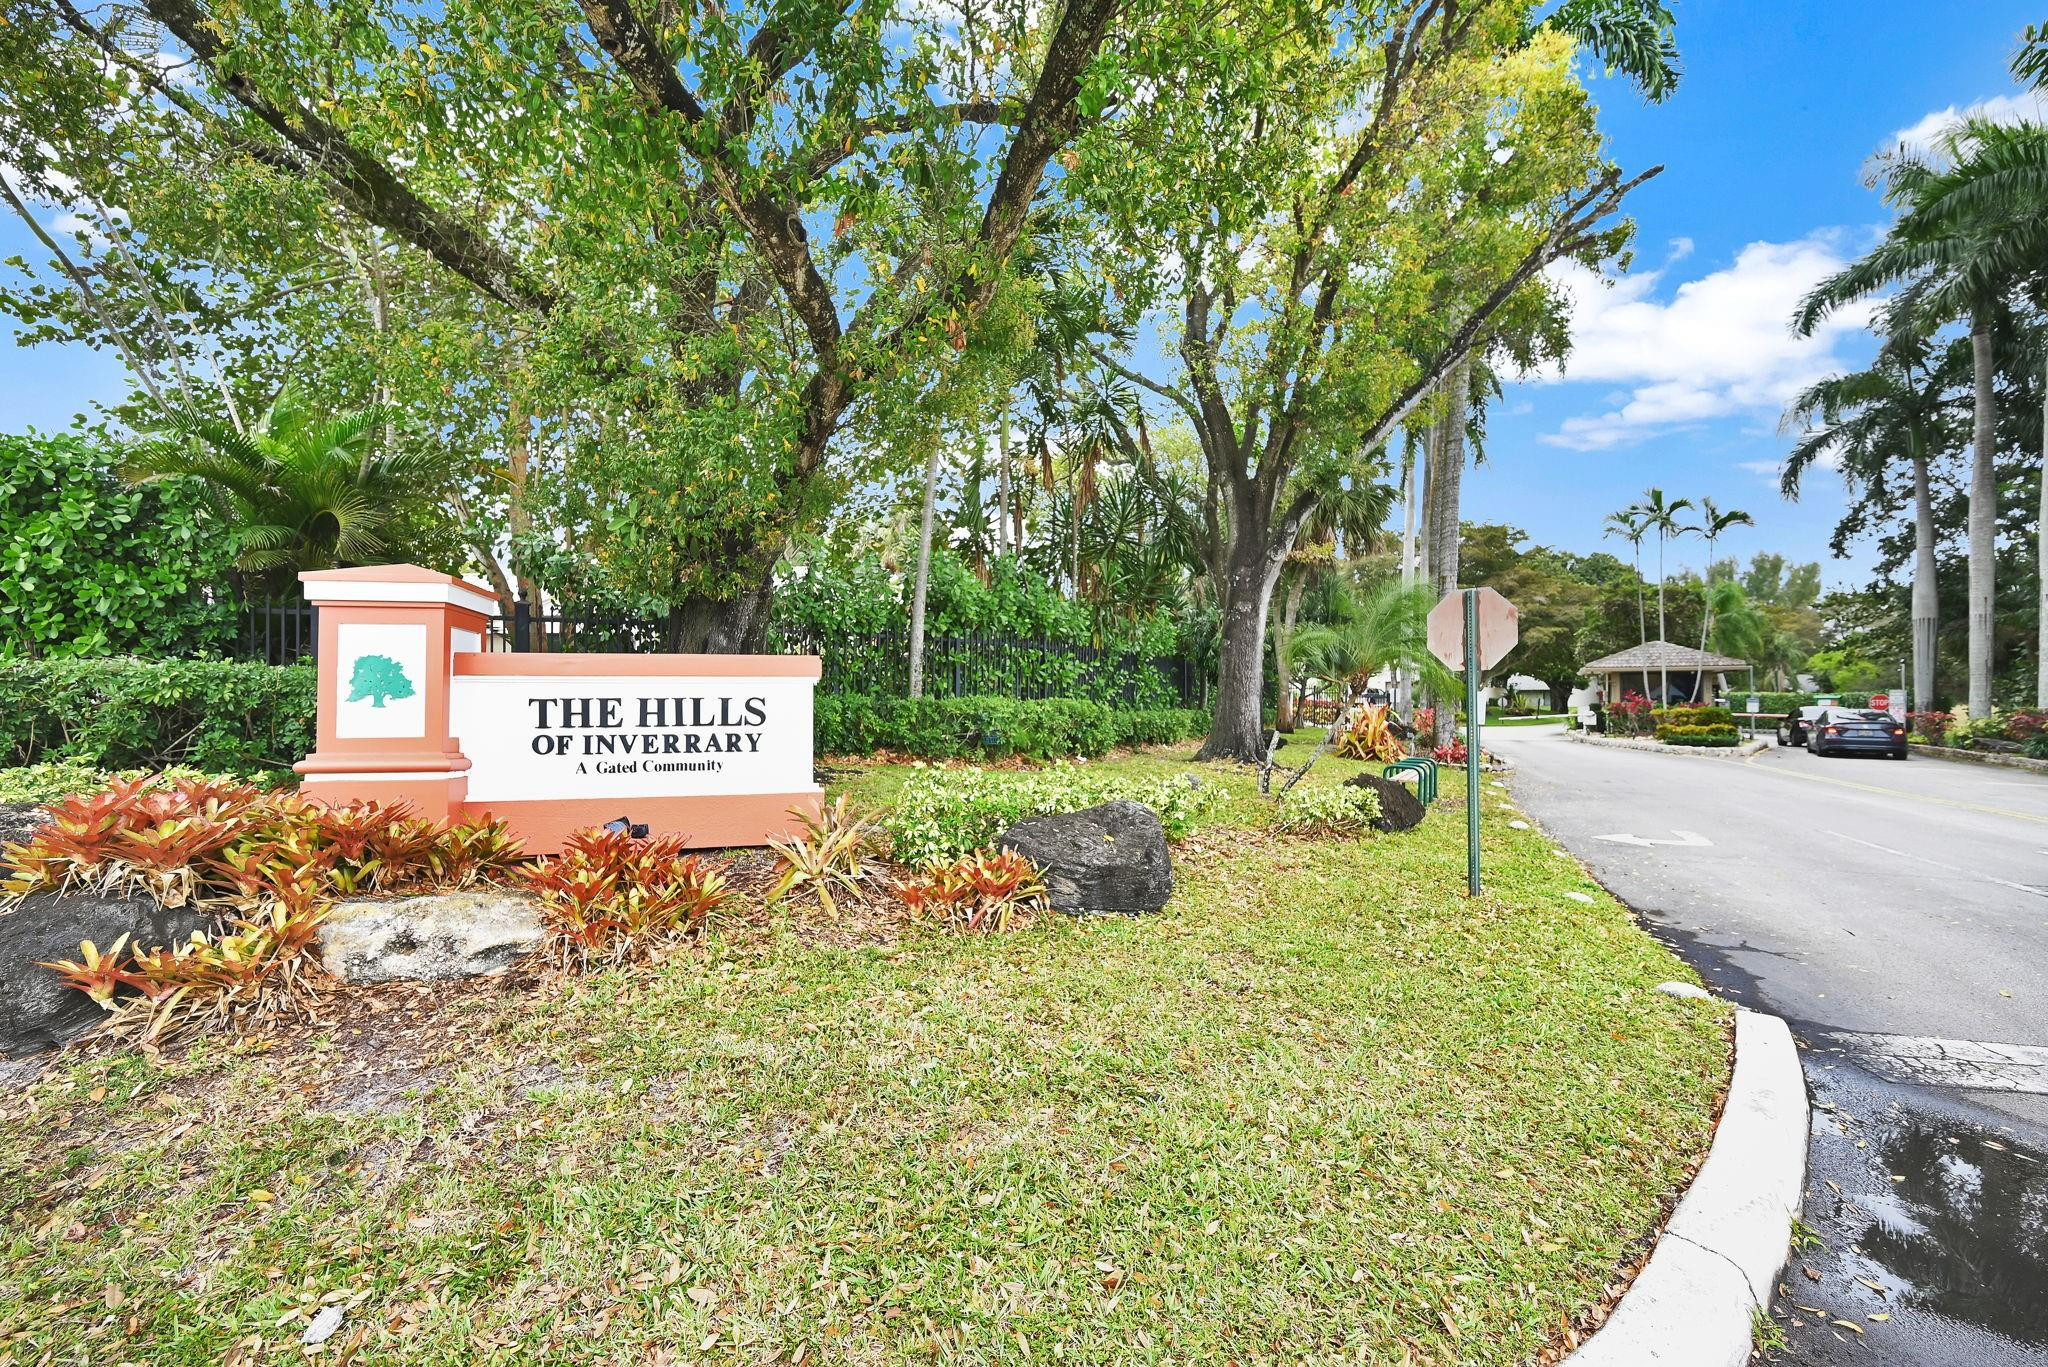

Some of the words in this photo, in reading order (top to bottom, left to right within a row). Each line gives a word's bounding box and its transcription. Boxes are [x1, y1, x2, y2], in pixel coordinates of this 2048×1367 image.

[528, 697, 624, 730] THE
[635, 696, 767, 729] HILLS
[1871, 699, 1889, 707] STOP
[531, 734, 574, 756] OF
[582, 733, 763, 756] INVERRARY
[575, 761, 588, 775] A
[596, 760, 638, 775] Gated
[642, 758, 725, 774] Community
